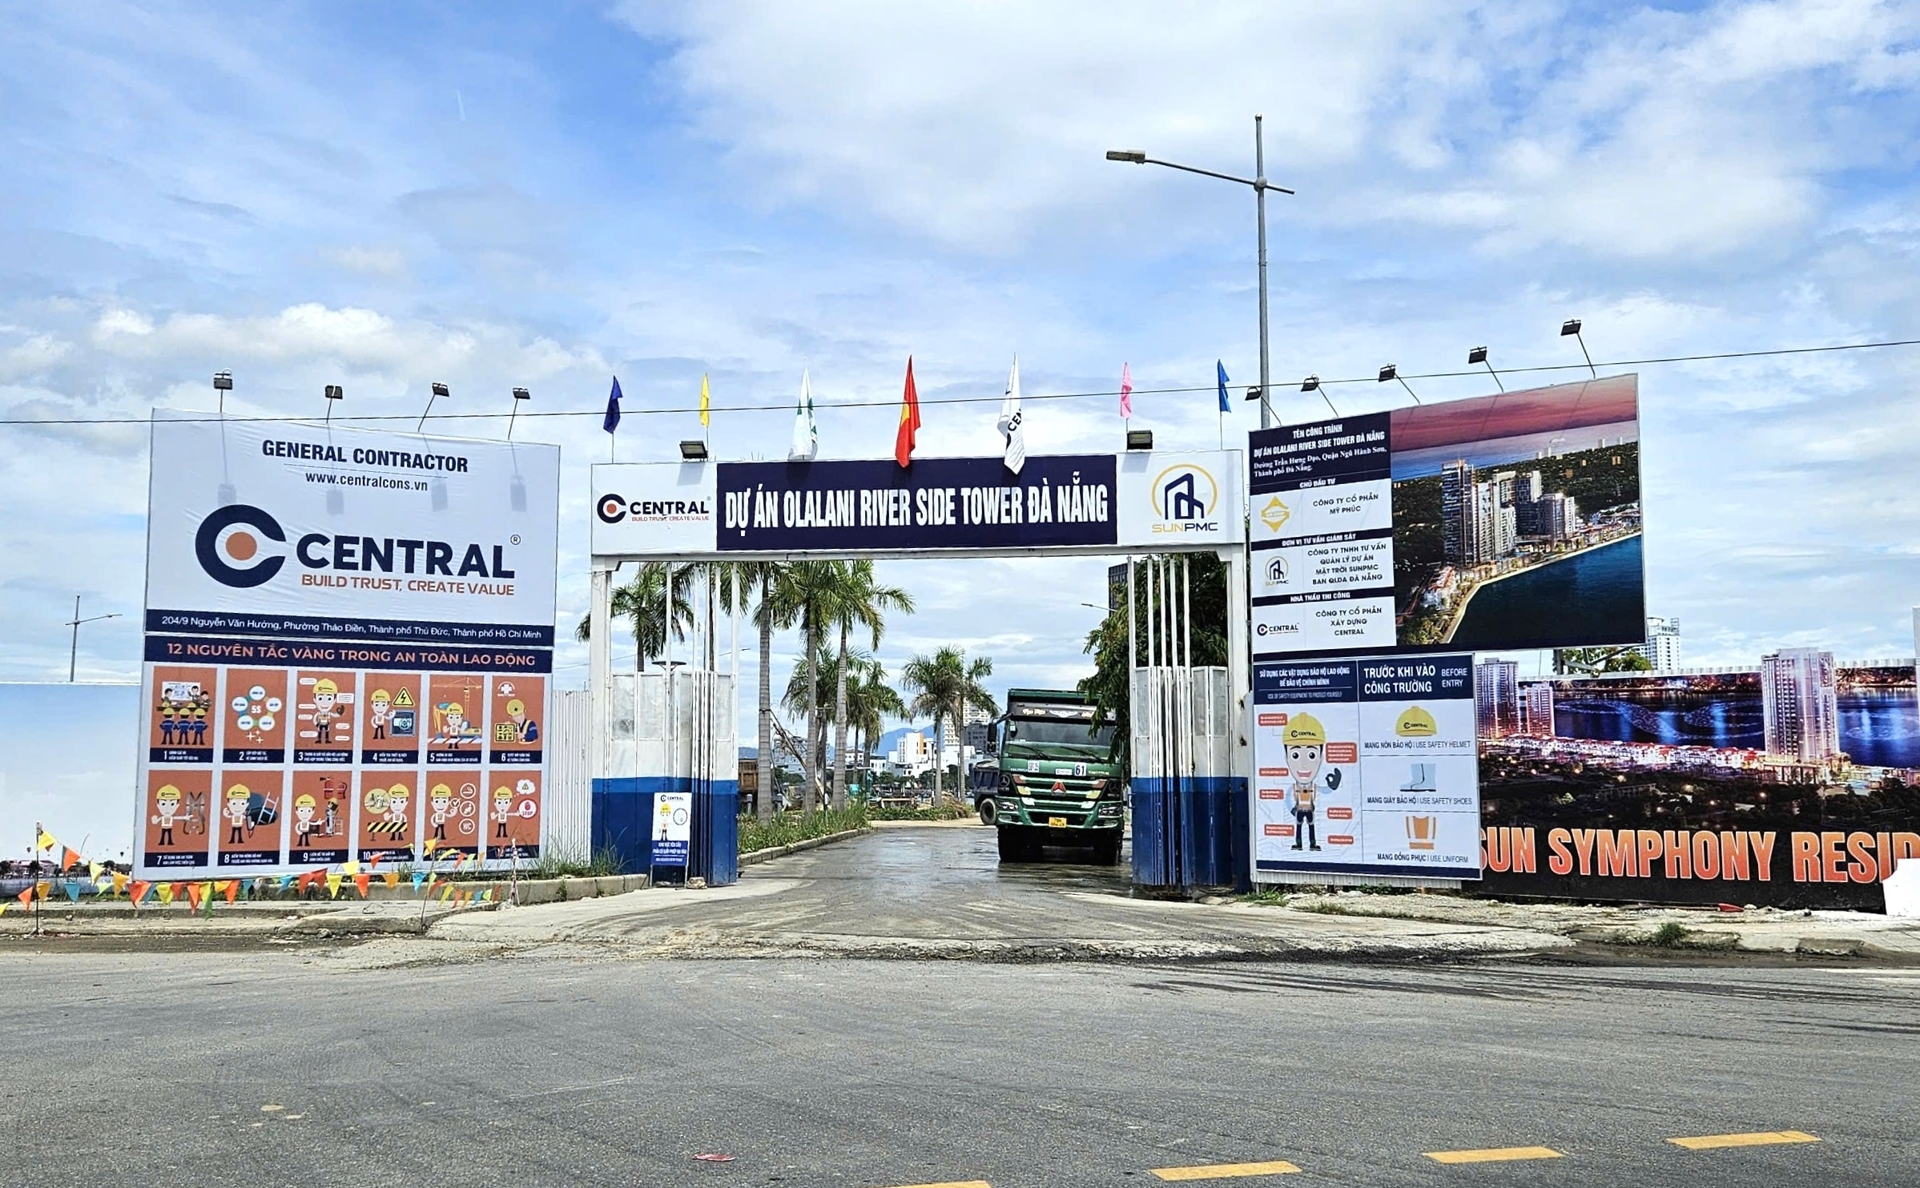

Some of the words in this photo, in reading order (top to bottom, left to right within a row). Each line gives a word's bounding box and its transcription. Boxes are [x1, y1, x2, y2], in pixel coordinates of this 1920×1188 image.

[1293, 428, 1304, 439] TÊN
[1305, 426, 1322, 437] CÔNG
[1324, 424, 1343, 435] TRÌNH
[1263, 445, 1272, 457] ÁN
[1273, 443, 1298, 455] OLALANI
[1298, 441, 1316, 452] RIVER
[1318, 439, 1332, 449] SIDE
[1333, 436, 1355, 447] TOWER
[1356, 433, 1365, 444] ĐÀ
[262, 440, 347, 463] GENERAL
[352, 448, 469, 473] CONTRACTOR
[305, 471, 428, 492] www.centralcons.vn
[725, 487, 751, 537] DỰ
[754, 483, 779, 529] ÁN
[783, 489, 855, 528] OLALANI
[860, 488, 911, 527] RIVER
[916, 487, 957, 526] SIDE
[960, 486, 1023, 525] TOWER
[1028, 477, 1052, 524] ĐÀ
[1057, 470, 1108, 523] NẴNG
[1313, 498, 1335, 508] CÔNG
[1337, 496, 1347, 505] TY
[1348, 492, 1359, 504] CỔ
[1360, 491, 1379, 503] PHẦN
[630, 501, 710, 516] CENTRAL
[1342, 505, 1361, 514] PHÚC
[1152, 522, 1219, 534] SUNPMC
[1307, 547, 1329, 556] CÔNG
[1330, 547, 1339, 555] TY
[1340, 546, 1359, 555] TNHH
[1361, 545, 1370, 553] TƯ
[1371, 541, 1387, 552] VẤN
[296, 533, 515, 580] CENTRAL
[1342, 555, 1350, 564] LÝ
[1351, 554, 1362, 565] DỰ
[1364, 553, 1374, 562] ÁN
[1349, 564, 1379, 574] SUNPMC
[301, 573, 347, 589] BUILD
[350, 576, 403, 593] TRUST,
[407, 579, 465, 595] CREATE
[467, 582, 515, 596] VALUE
[1312, 578, 1327, 586] BAN
[1328, 576, 1348, 585] QLDA
[1349, 573, 1360, 583] ĐÀ
[1332, 591, 1351, 601] CÔNG
[1315, 609, 1338, 618] CÔNG
[1339, 608, 1347, 617] TY
[1348, 606, 1360, 616] CỔ
[1362, 605, 1382, 615] PHẦN
[161, 616, 188, 626] 204/9
[190, 617, 226, 629] Nguyễn
[228, 618, 245, 628] Văn
[283, 621, 319, 633] Phường
[344, 623, 367, 635] Điền,
[368, 625, 394, 635] Thành
[396, 625, 412, 637] phố
[414, 626, 430, 636] Thủ
[431, 627, 451, 638] Đức,
[452, 628, 477, 638] Thành
[478, 628, 494, 640] phố
[495, 629, 507, 638] Hồ
[508, 629, 522, 639] Chí
[523, 630, 542, 640] Minh
[1330, 618, 1346, 627] XÂY
[1346, 617, 1368, 627] DỰNG
[1268, 625, 1299, 633] CENTRAL
[1334, 627, 1365, 637] CENTRAL
[167, 643, 183, 655] 12
[187, 642, 254, 658] NGUYÊN
[258, 642, 288, 659] TẮC
[292, 644, 335, 660] VÀNG
[340, 649, 391, 662] TRONG
[394, 652, 415, 664] AN
[419, 649, 459, 665] TOÀN
[463, 654, 491, 666] LAO
[495, 652, 536, 669] ĐỘNG
[1364, 664, 1395, 678] TRƯỚC
[1397, 665, 1414, 677] KHI
[1414, 662, 1436, 677] VÀO
[1441, 667, 1468, 677] BEFORE
[1364, 680, 1391, 695] CÔNG
[1393, 678, 1433, 693] TRƯỜNG
[1441, 678, 1463, 688] ENTRY
[1393, 739, 1404, 748] BẢO
[1404, 740, 1412, 750] HỘ
[239, 751, 245, 760] 2
[298, 752, 304, 761] 3
[372, 752, 378, 761] 4
[430, 752, 435, 761] 5
[501, 752, 506, 761] 6
[1075, 764, 1085, 776] 61
[1367, 796, 1382, 804] MANG
[157, 855, 162, 865] 7
[224, 854, 230, 863] 8
[303, 853, 308, 861] 9
[1377, 853, 1393, 861] MANG
[1548, 827, 1776, 882] SYMPHONY
